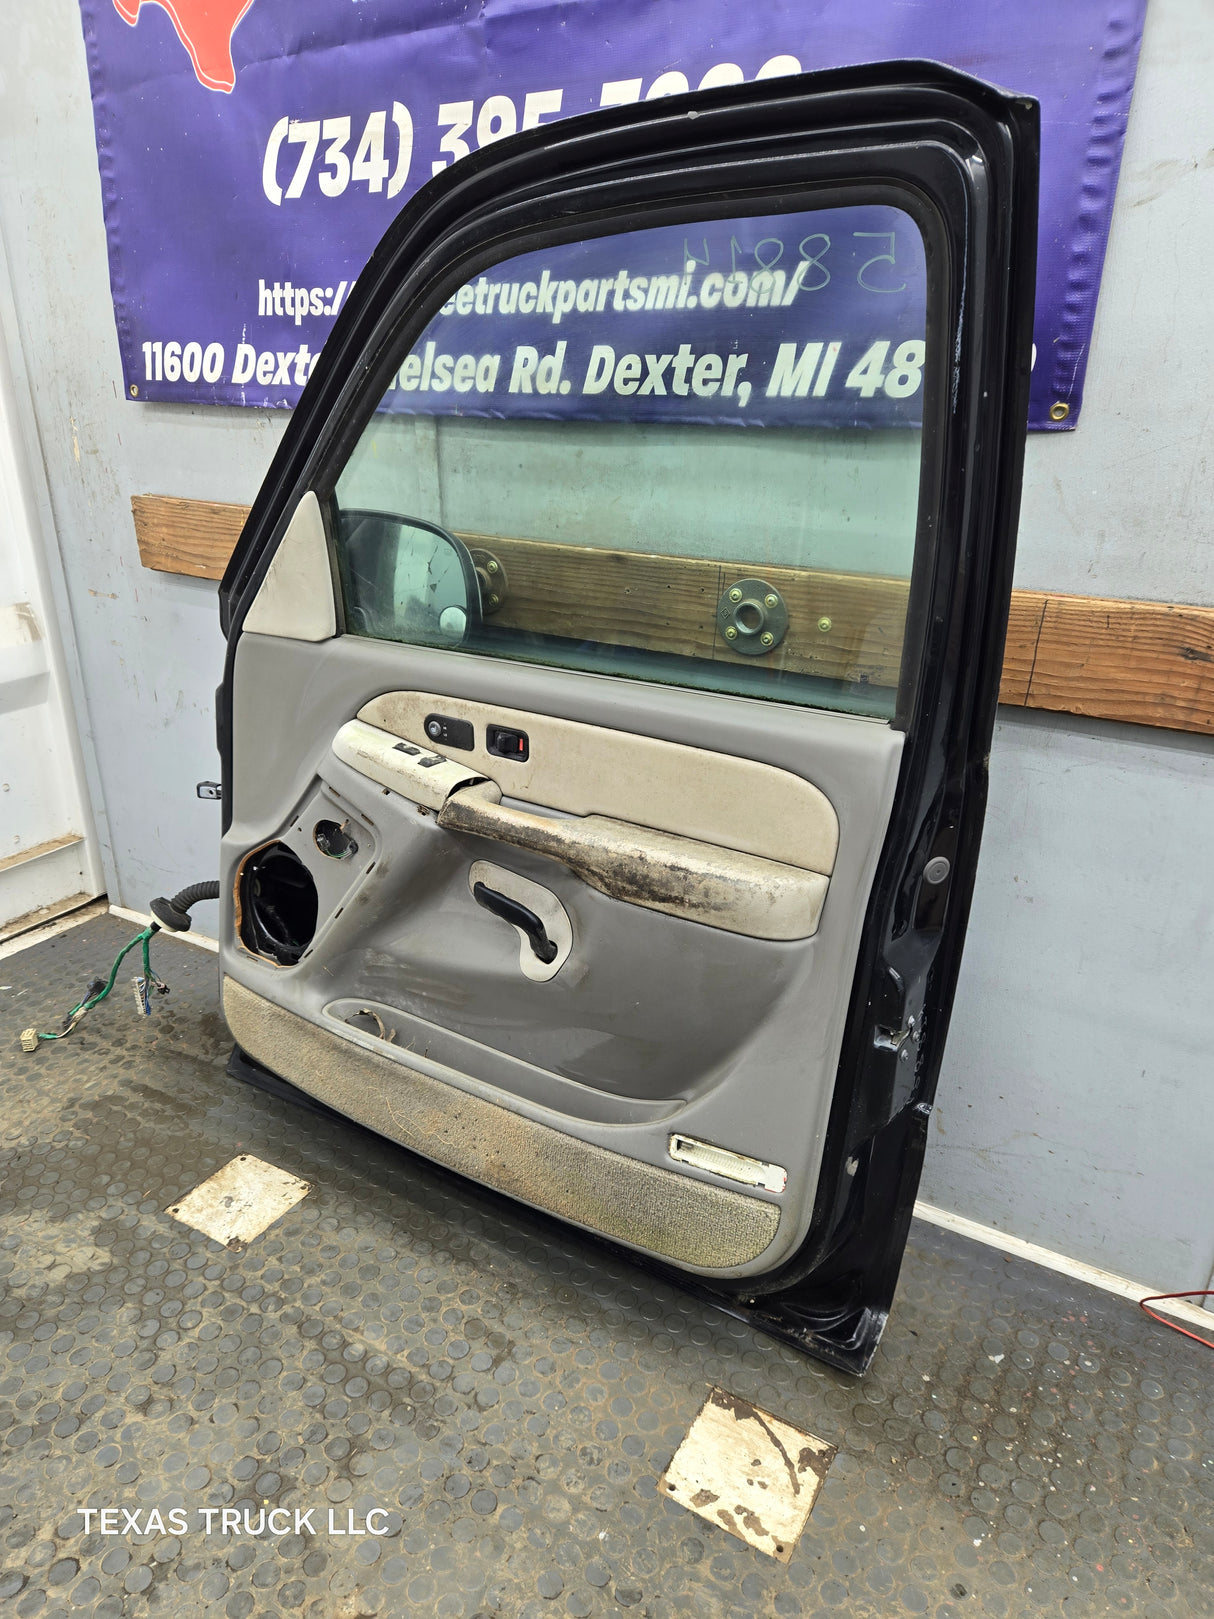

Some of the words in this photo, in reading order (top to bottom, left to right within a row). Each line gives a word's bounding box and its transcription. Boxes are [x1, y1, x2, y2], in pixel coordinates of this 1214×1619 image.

[262, 100, 412, 206] (734)
[142, 341, 224, 383] 11600
[231, 343, 323, 387] Dext
[388, 341, 500, 393] elsea
[508, 341, 572, 395] Rd.
[582, 343, 752, 408] Dexter,
[765, 342, 837, 397] MI
